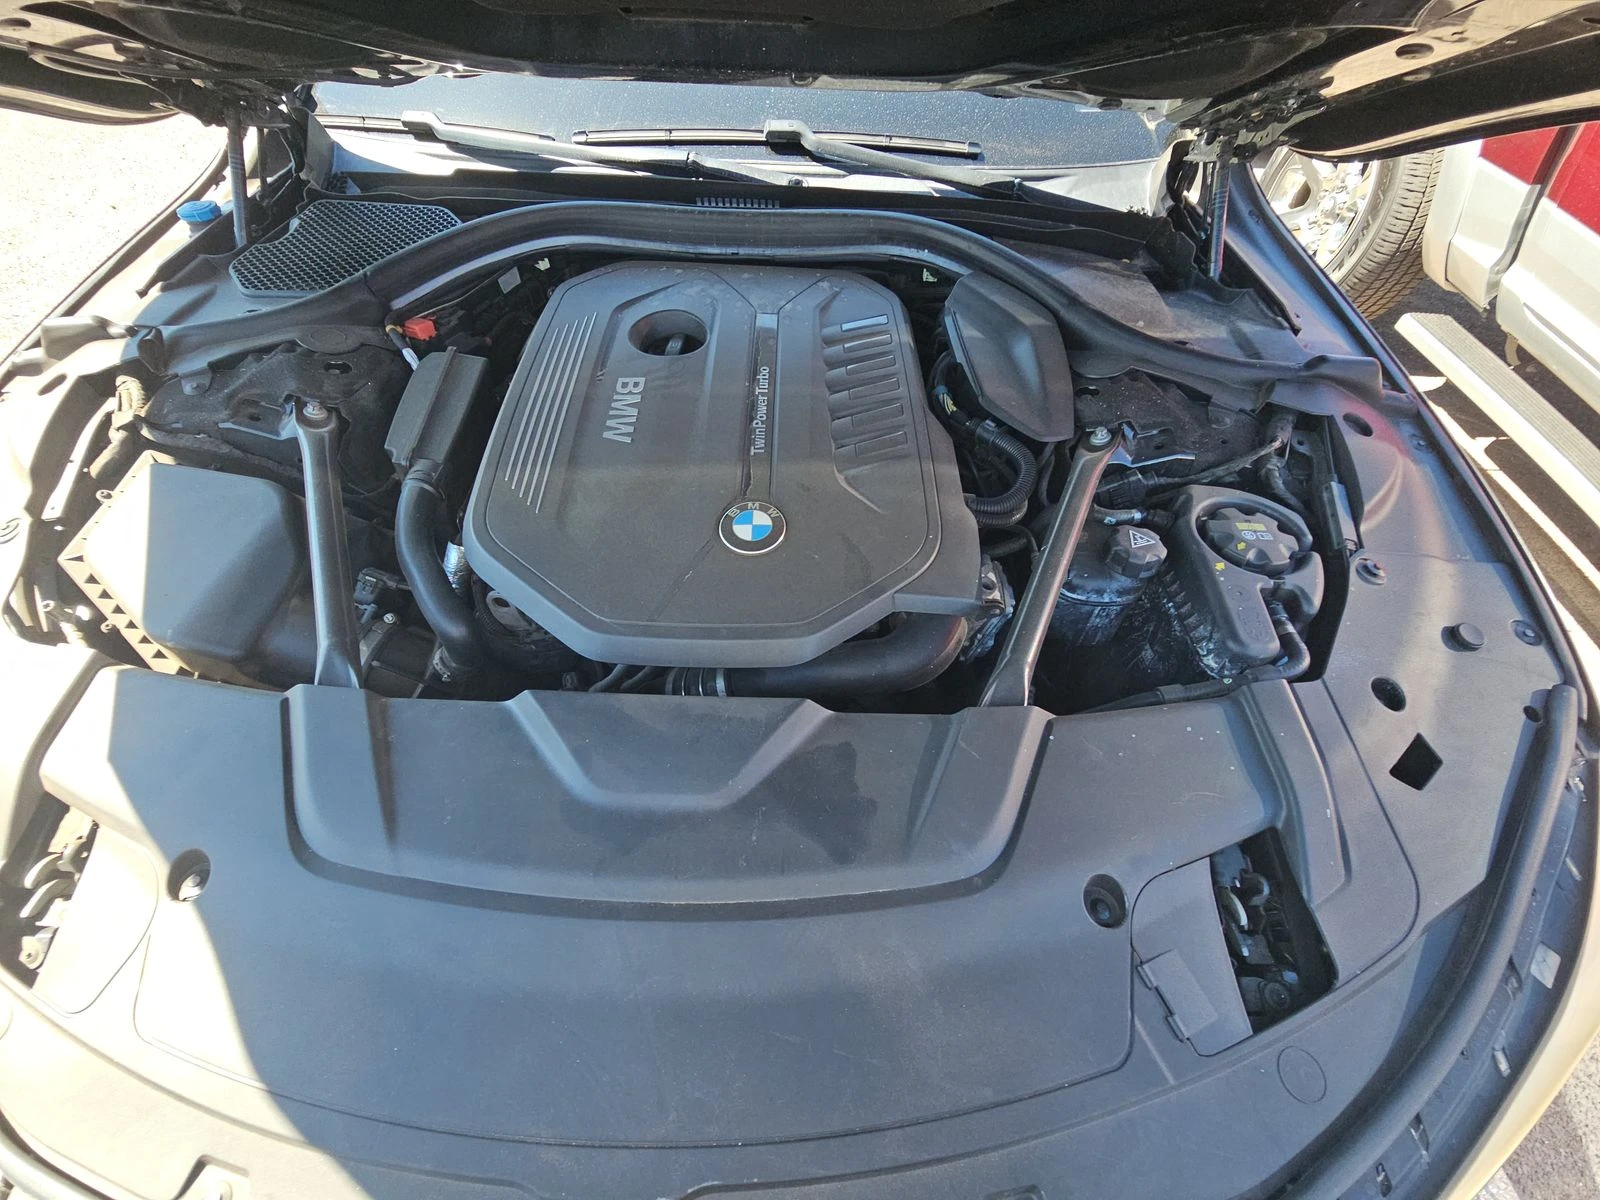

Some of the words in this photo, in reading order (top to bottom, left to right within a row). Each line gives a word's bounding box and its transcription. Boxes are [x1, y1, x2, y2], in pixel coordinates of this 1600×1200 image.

[755, 366, 770, 395] Turbo
[602, 376, 646, 443] BMW
[749, 395, 768, 456] TwinPower
[728, 502, 780, 518] BMW
